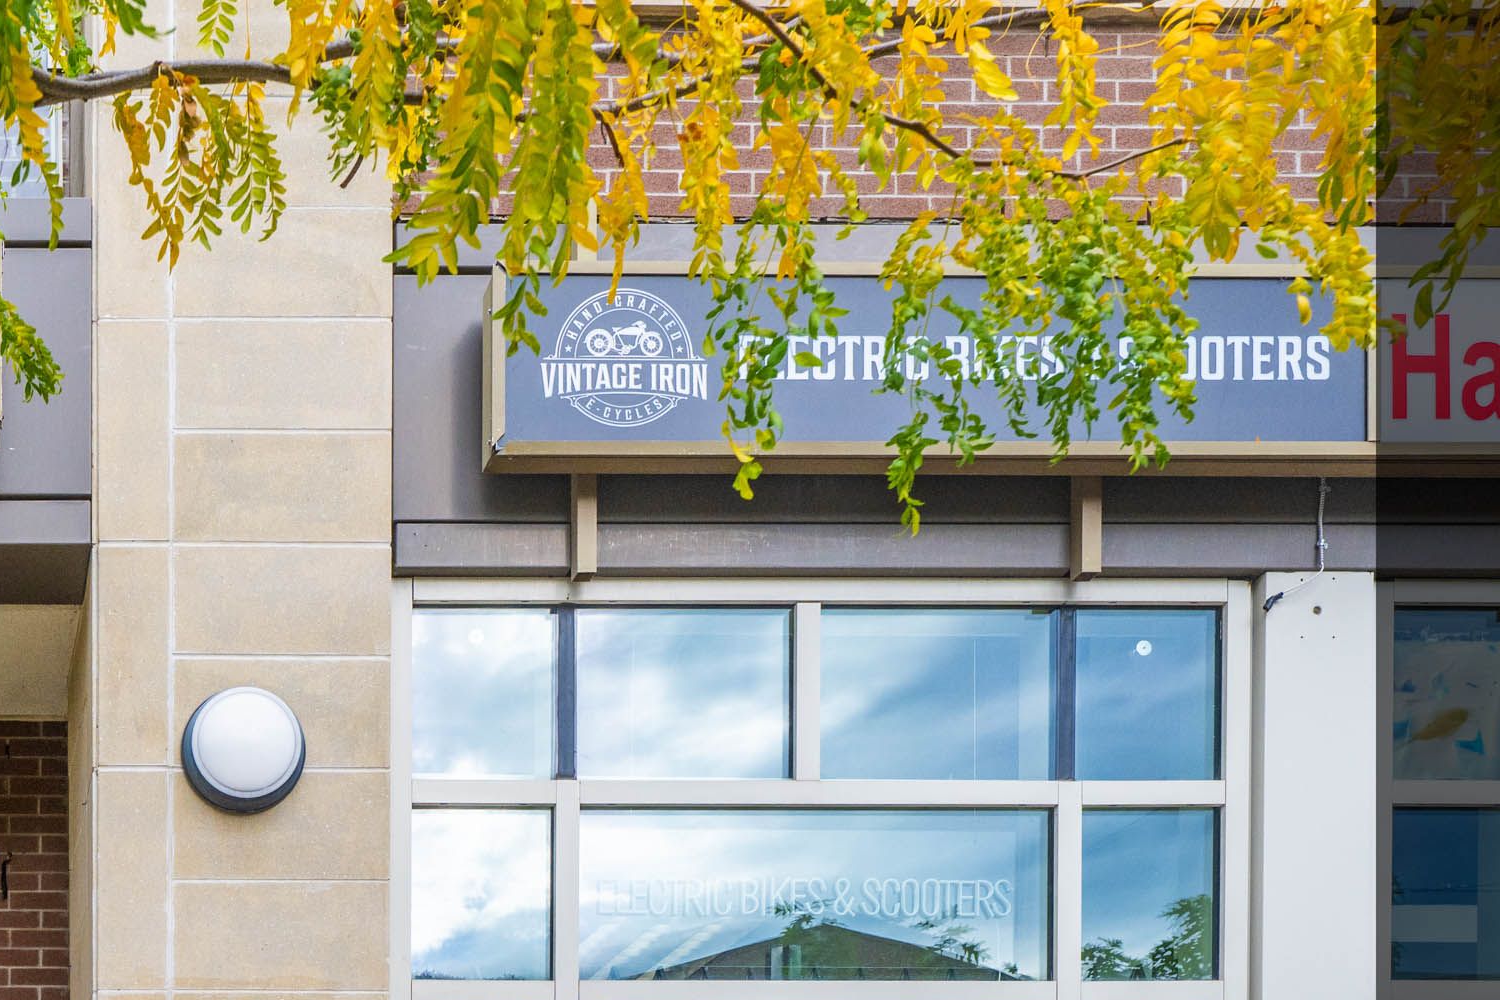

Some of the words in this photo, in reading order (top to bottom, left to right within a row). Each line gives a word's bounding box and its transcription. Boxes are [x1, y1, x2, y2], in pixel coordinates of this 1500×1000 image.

[1118, 335, 1331, 381] SOOTERS
[540, 362, 643, 400] VINTAGE
[651, 362, 709, 401] IRON
[585, 396, 663, 421] E-CYCLES
[596, 878, 732, 916] ELECTRIC
[741, 877, 830, 916] BIKES
[833, 877, 857, 917] &
[862, 878, 1013, 918] SCOOTERS
